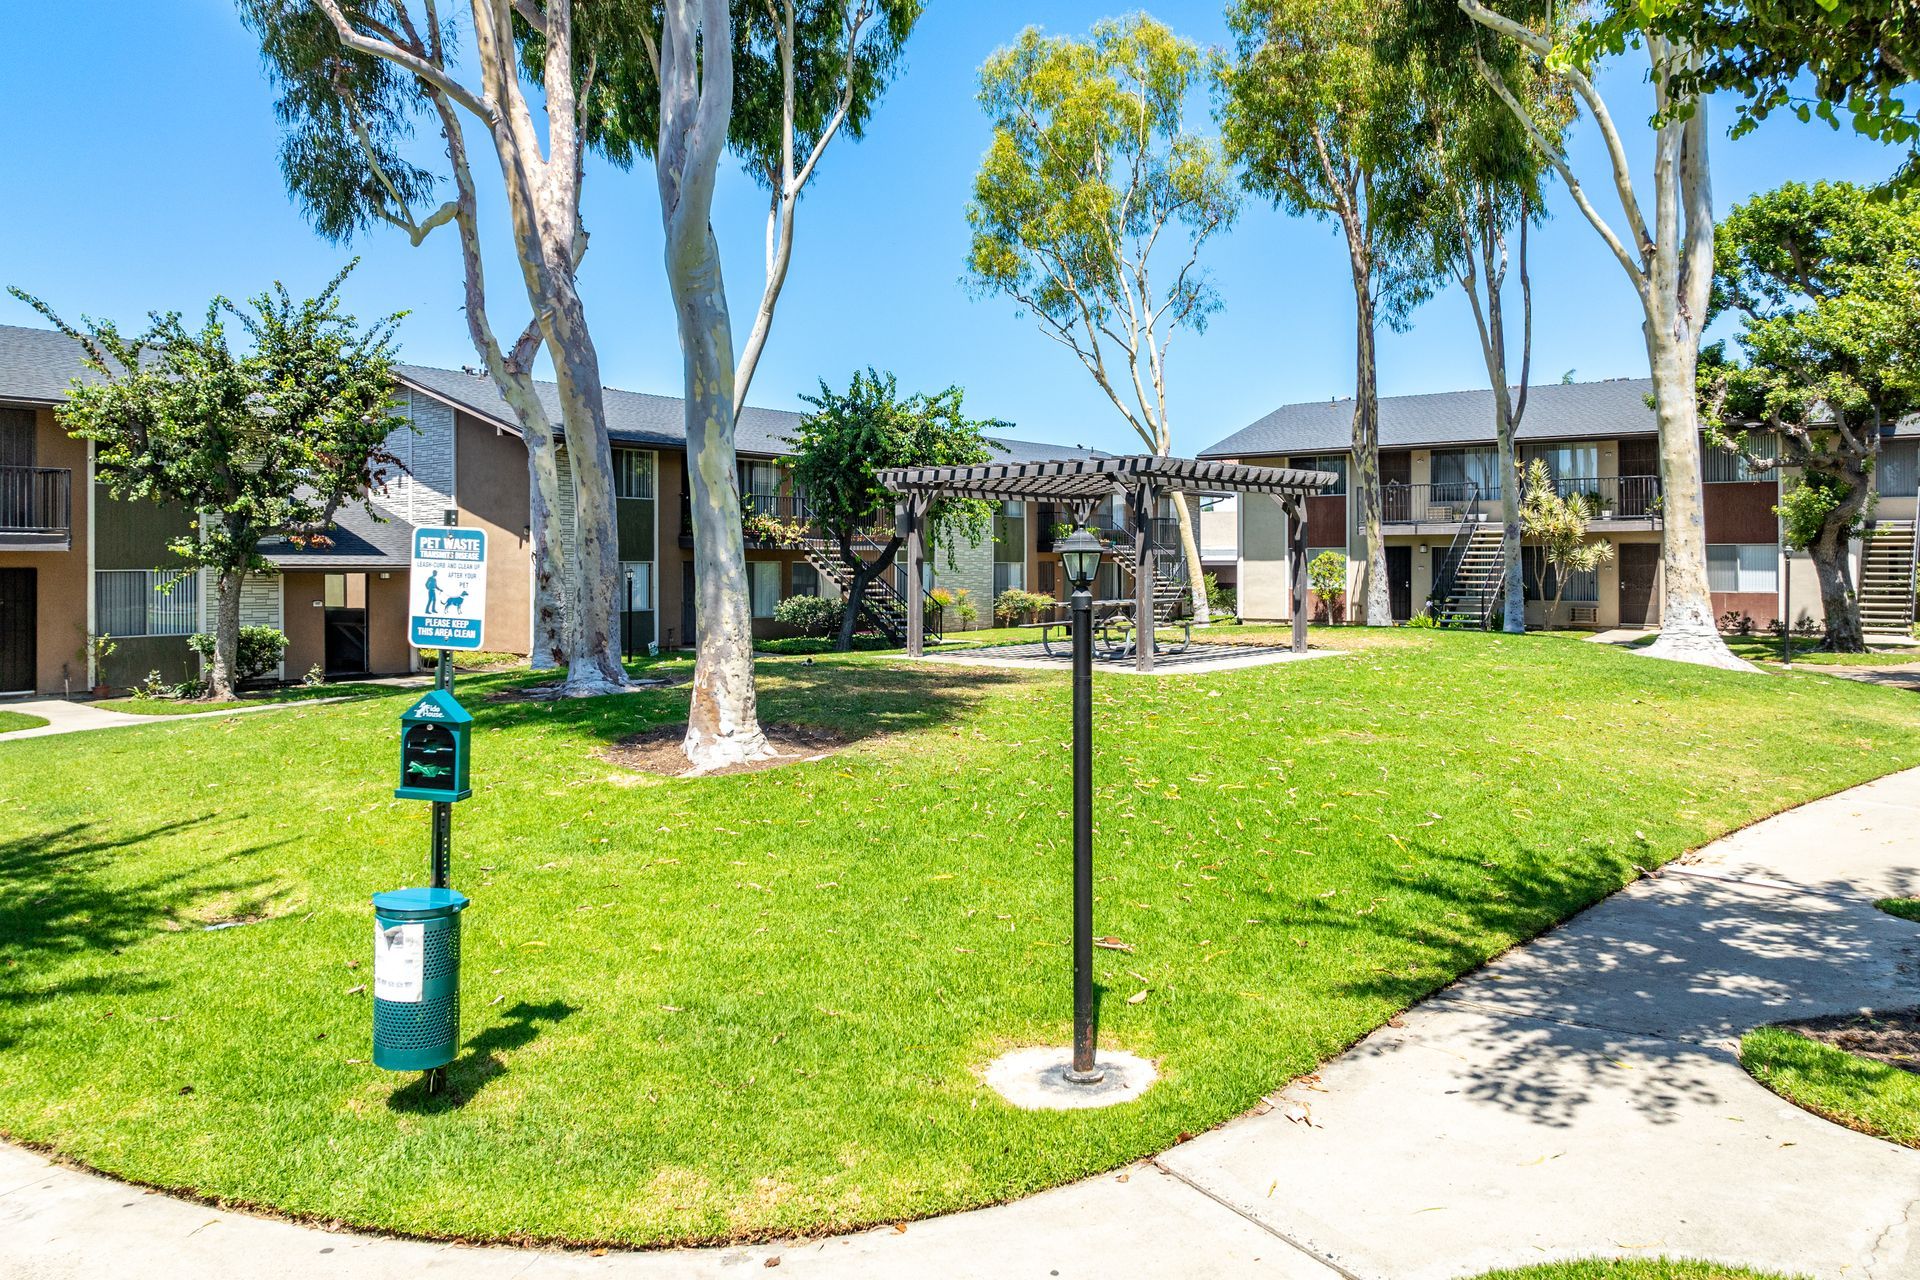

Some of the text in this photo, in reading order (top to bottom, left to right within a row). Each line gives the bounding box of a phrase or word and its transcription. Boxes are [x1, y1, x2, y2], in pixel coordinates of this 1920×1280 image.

[420, 537, 480, 550] PET WASTE
[455, 552, 480, 560] DISEASE
[425, 618, 469, 628] PLEASE KEEP
[417, 627, 476, 638] THIS AREA CLEAN
